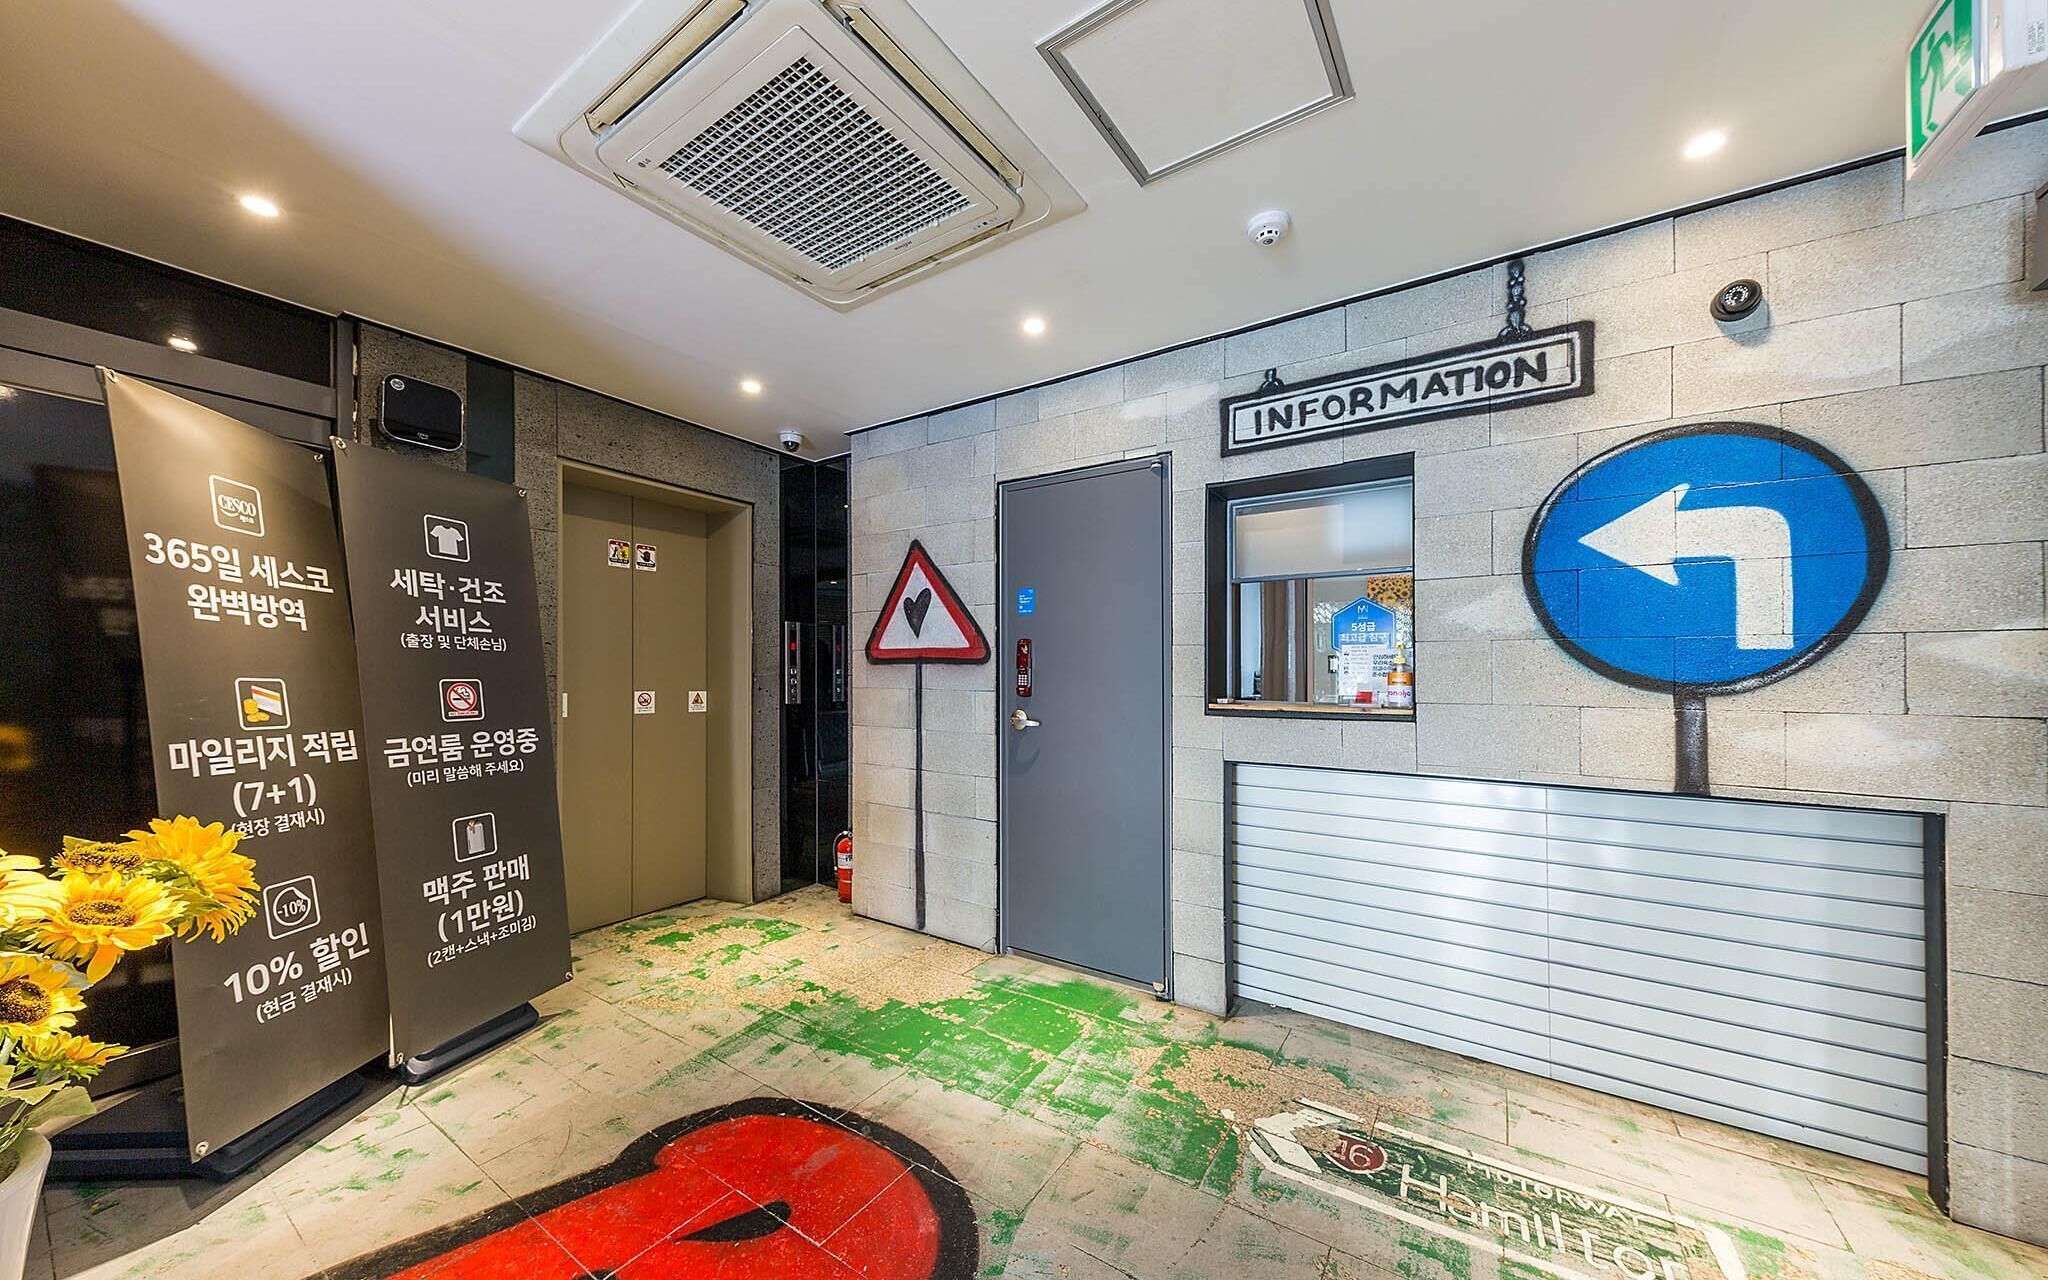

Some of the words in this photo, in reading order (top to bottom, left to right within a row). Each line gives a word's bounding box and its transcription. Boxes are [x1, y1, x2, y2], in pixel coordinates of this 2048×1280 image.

[1254, 352, 1547, 435] INFORMATION
[218, 494, 257, 517] CESCO
[143, 532, 243, 584] 365일
[250, 554, 334, 593] 세스코
[187, 584, 308, 631] 완벽방역
[415, 605, 493, 635] 서비스
[1351, 622, 1376, 632] 5성급
[400, 632, 434, 649] (출장
[437, 635, 451, 650] 및
[453, 636, 507, 652] 단체손님)
[168, 733, 297, 778] 마일리지
[302, 729, 359, 764] 적립
[383, 733, 465, 769] 금연룸
[470, 728, 540, 759] 운영중
[233, 773, 317, 817] (7+1)
[407, 768, 440, 788] (미리
[443, 763, 483, 783] 말씀해
[484, 758, 525, 776] 주세요)
[274, 807, 326, 832] 결재시)
[422, 870, 477, 906] 맥주
[482, 854, 530, 892] 판매
[277, 899, 306, 918] -10%
[438, 889, 524, 943] (1만원)
[223, 950, 304, 1004] 10%
[309, 922, 370, 974] 할인
[427, 914, 537, 969] (2캔+스낵+조미김)
[256, 990, 297, 1024] (현금
[300, 967, 352, 1004] 결재시)
